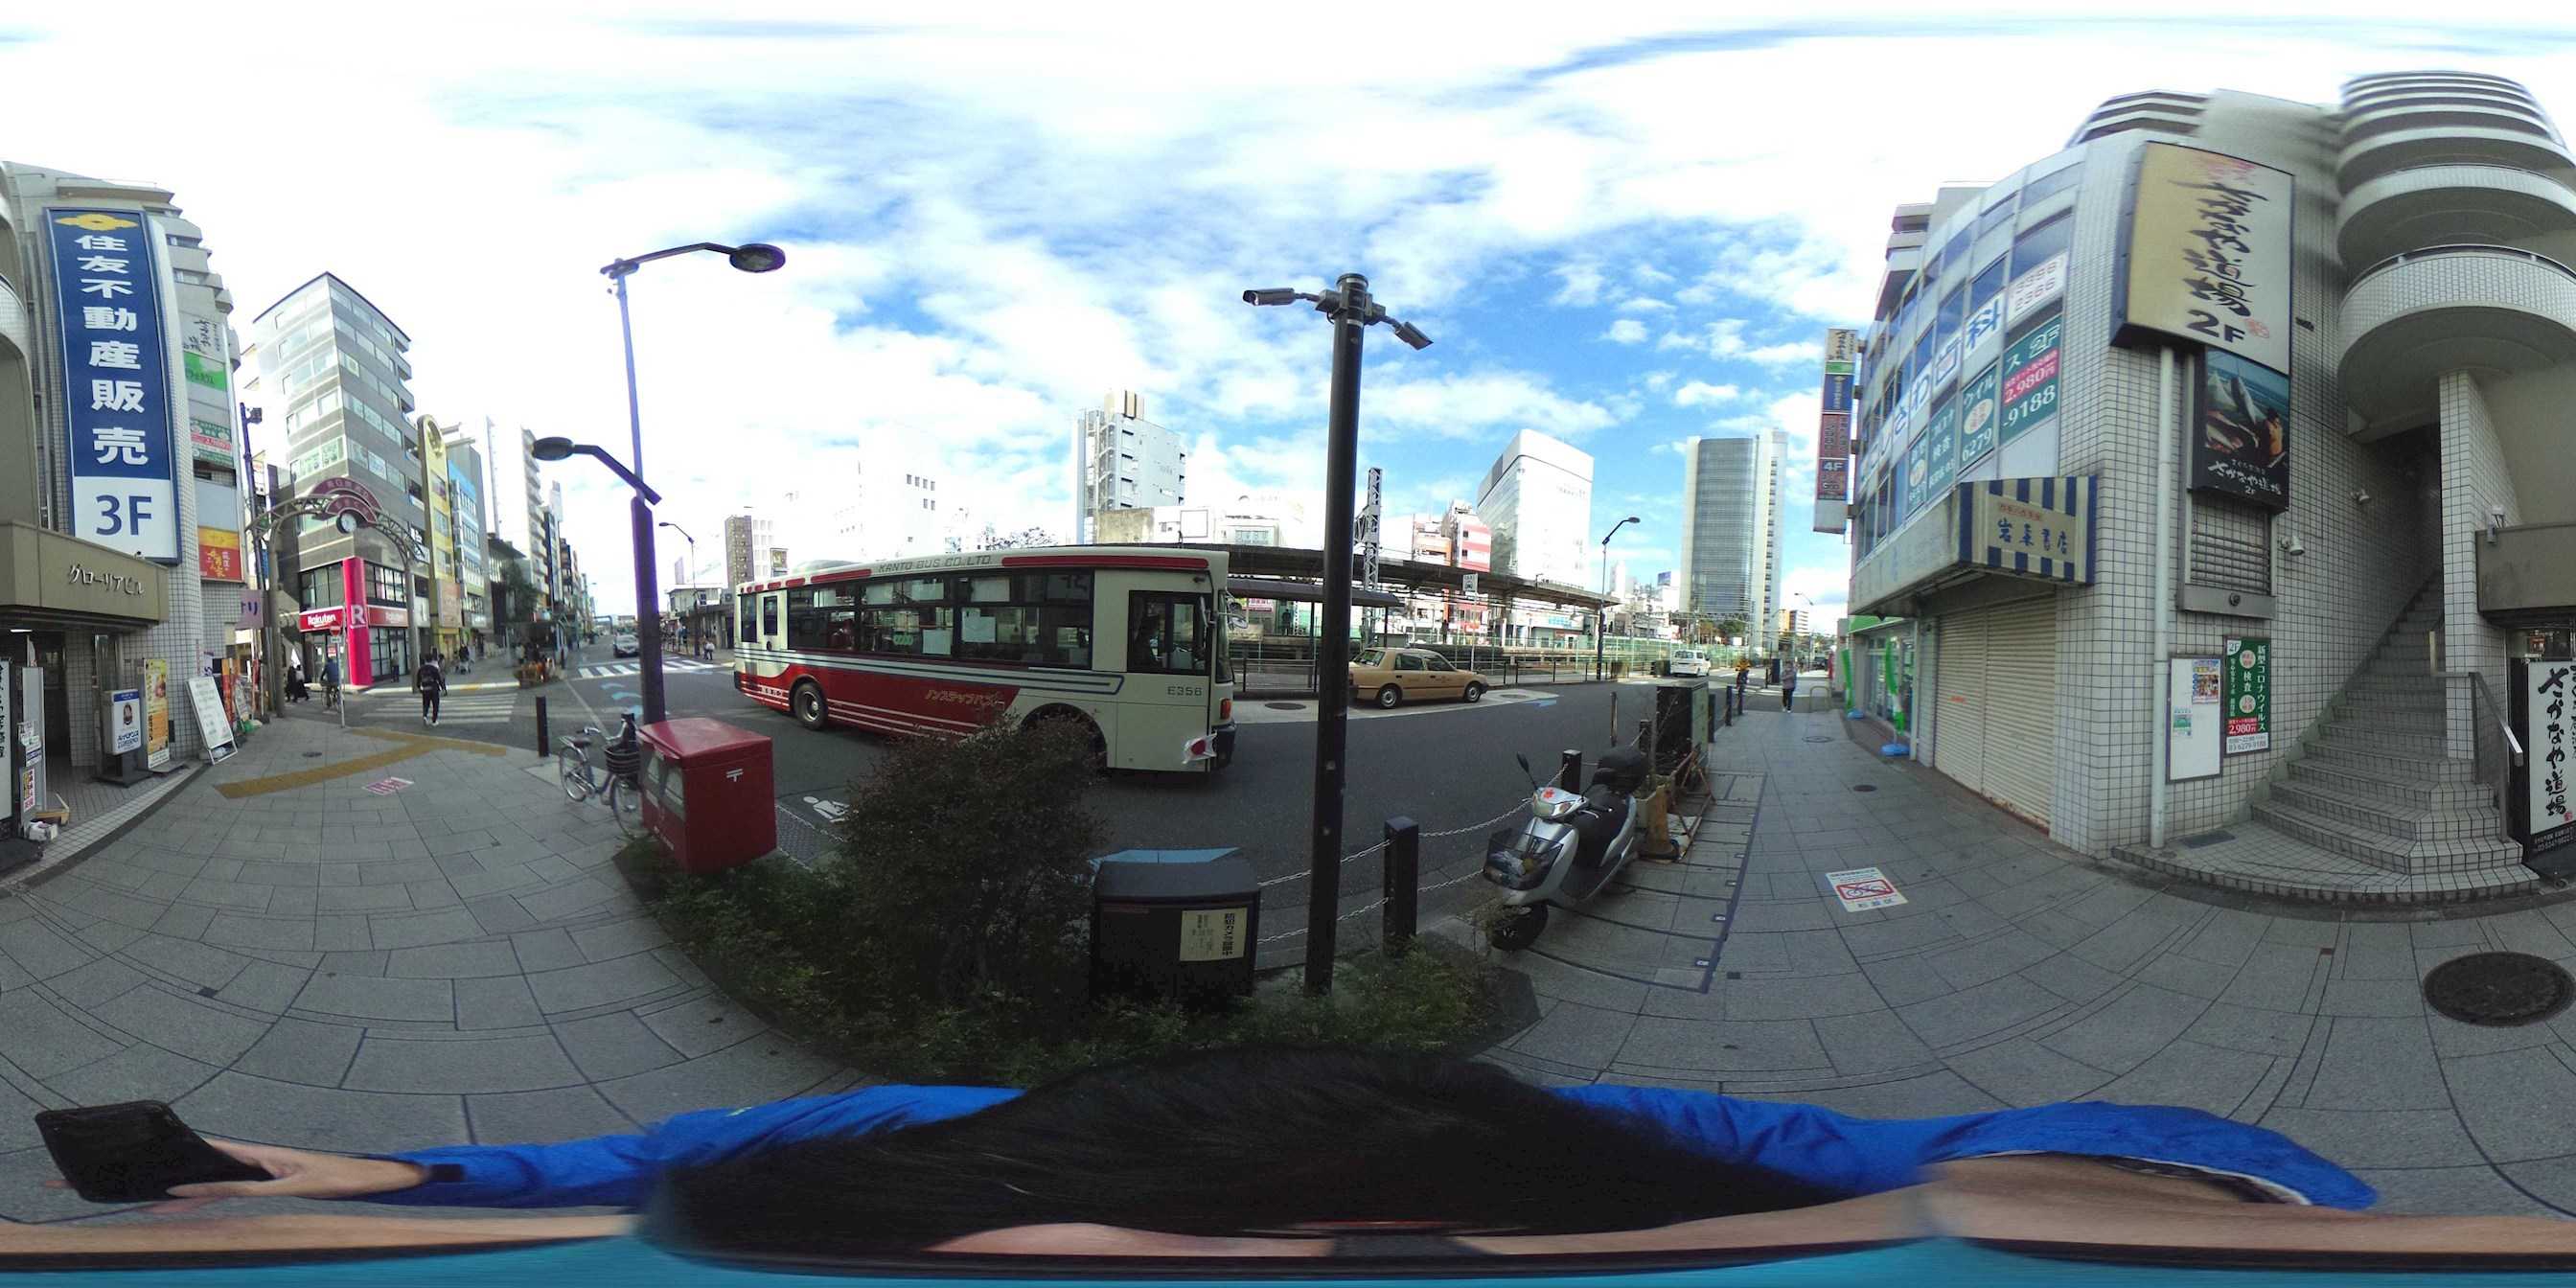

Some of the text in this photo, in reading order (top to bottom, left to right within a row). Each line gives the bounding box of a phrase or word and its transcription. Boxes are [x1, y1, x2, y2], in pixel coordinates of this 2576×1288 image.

[2029, 324, 2059, 358] 2F
[2184, 308, 2245, 343] 2F
[75, 235, 148, 465] 住友不動産販売
[1824, 462, 1843, 472] 4F
[96, 494, 152, 537] 3F
[69, 564, 146, 596] グローリアビル
[878, 562, 913, 573] KANTO
[916, 559, 941, 568] BUS
[308, 613, 336, 627] Rakuten
[351, 604, 366, 625] R
[1167, 685, 1203, 697] E356
[2243, 671, 2252, 692] 検査
[2257, 645, 2266, 731] 新型コロナウイルス
[2538, 667, 2569, 816] さかなや道場
